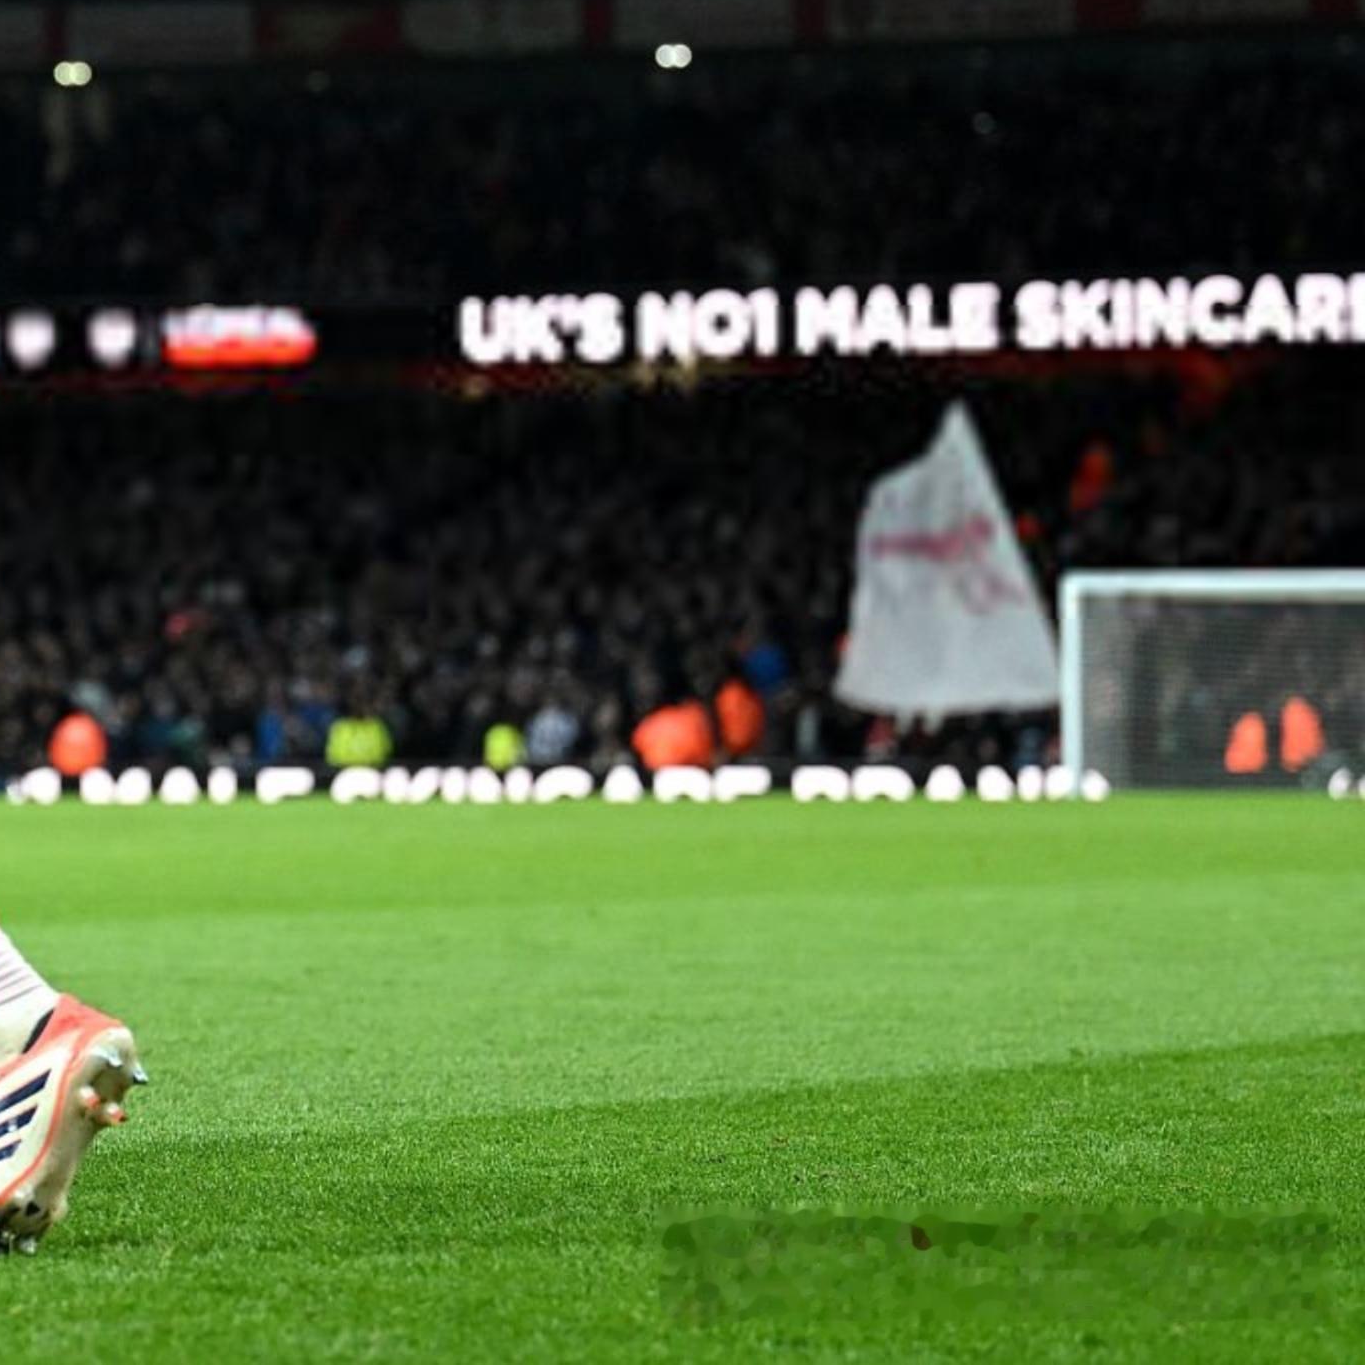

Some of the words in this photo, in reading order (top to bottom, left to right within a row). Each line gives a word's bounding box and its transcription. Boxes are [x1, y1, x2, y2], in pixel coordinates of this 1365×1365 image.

[459, 292, 622, 363] UK'S
[635, 287, 778, 360] NO1
[795, 282, 1000, 356] MALE
